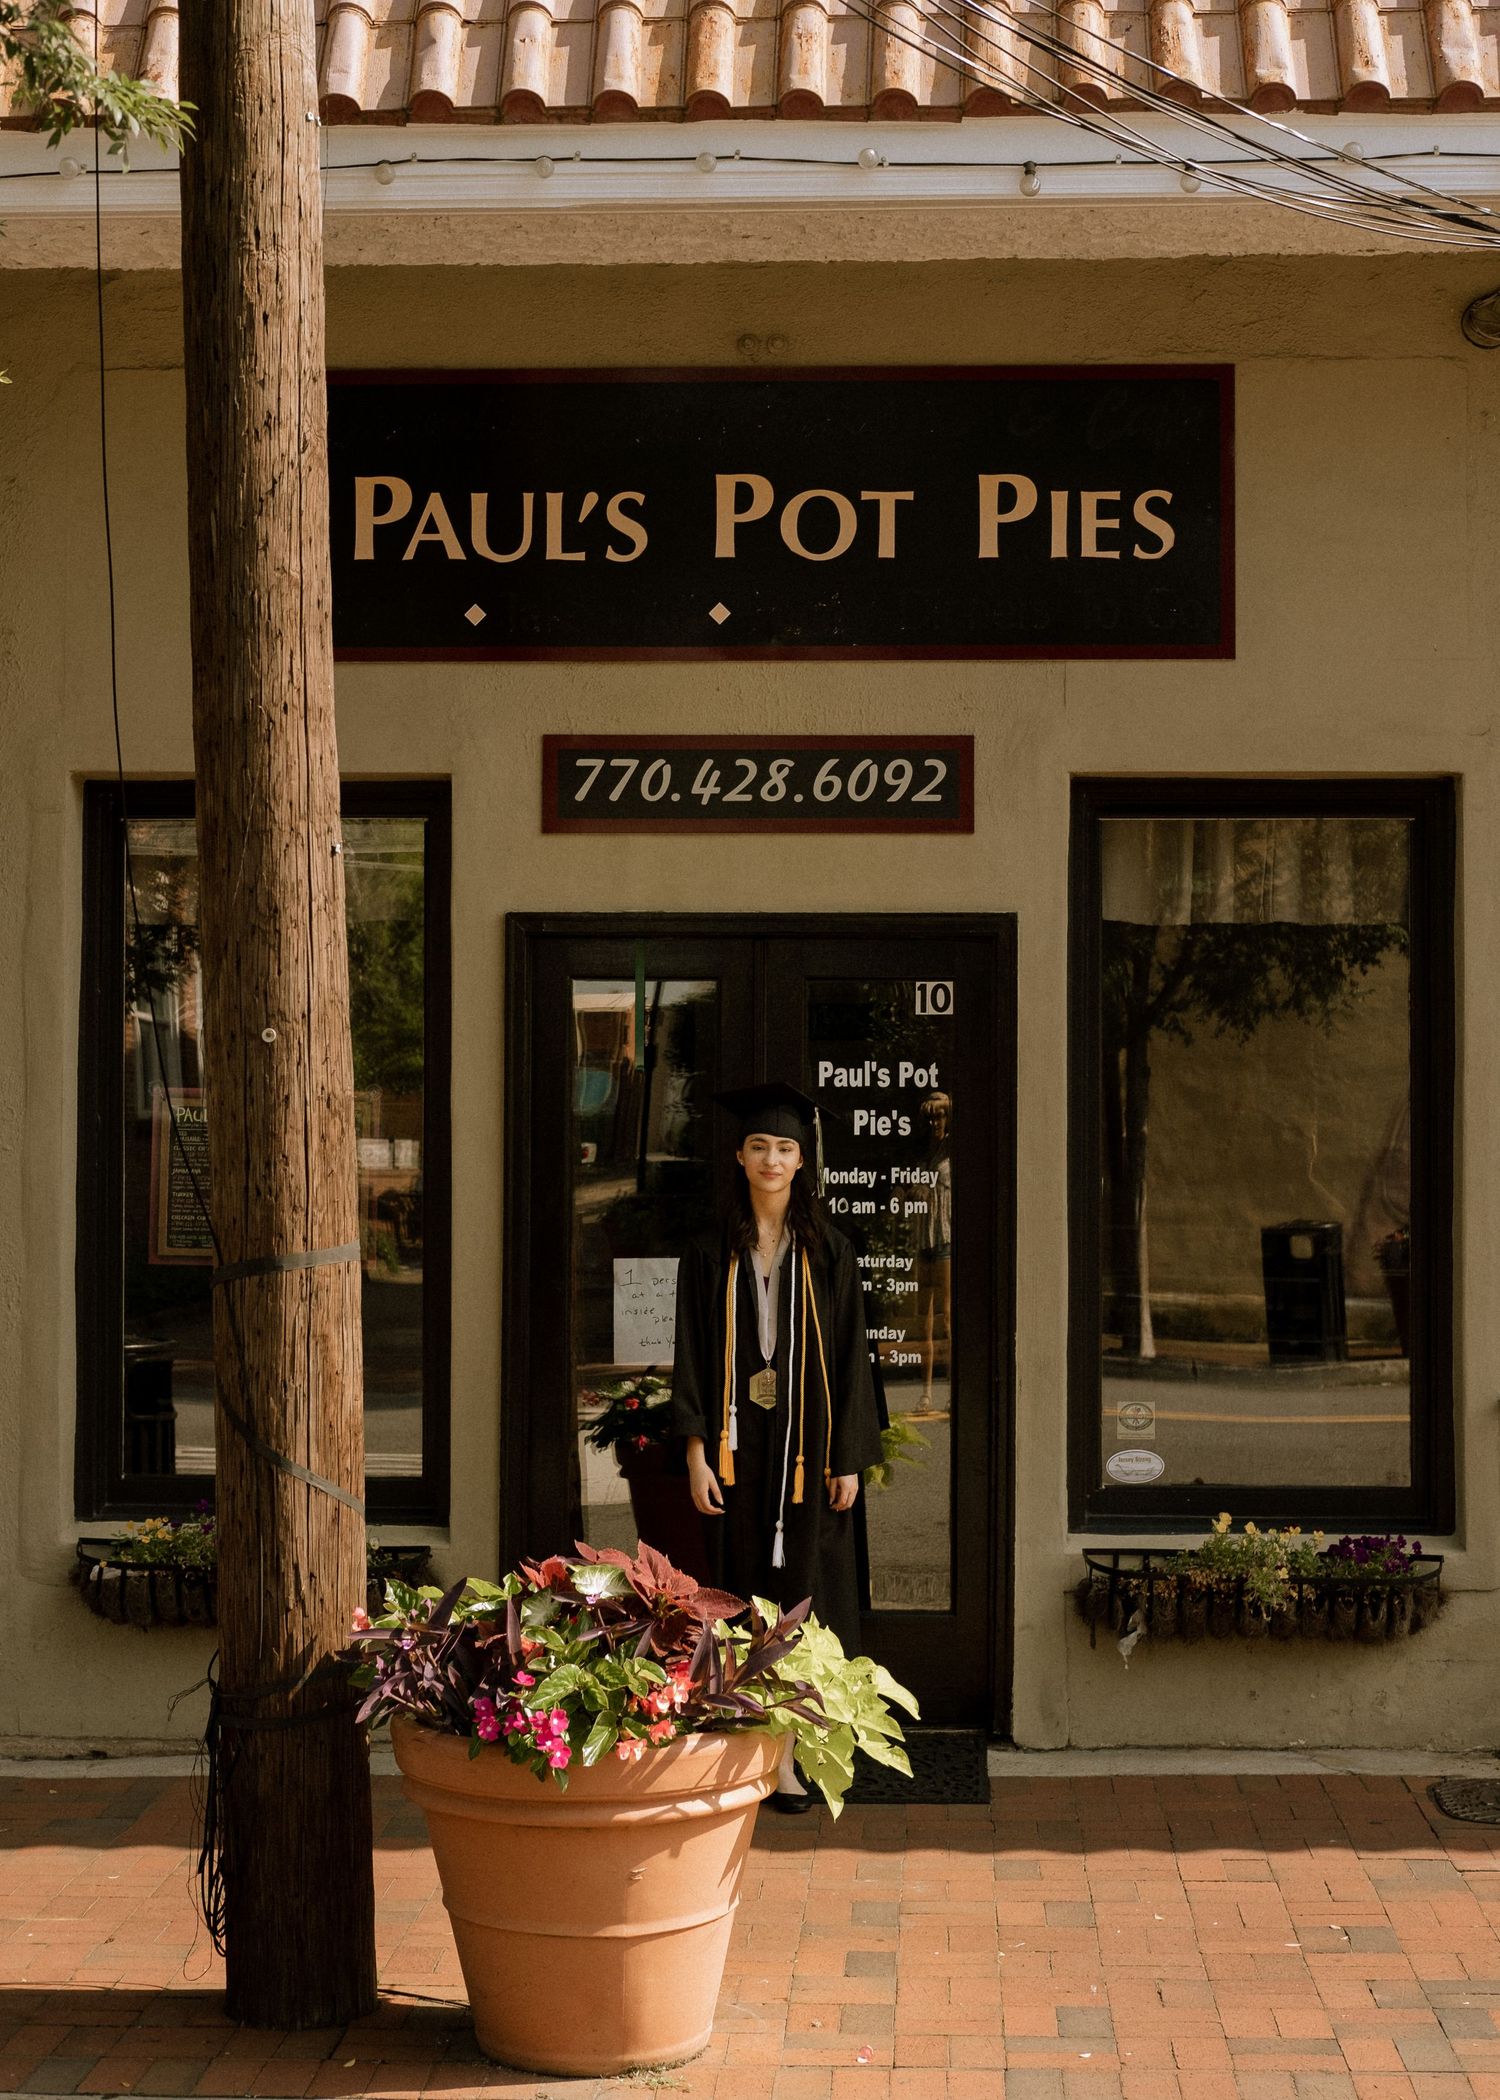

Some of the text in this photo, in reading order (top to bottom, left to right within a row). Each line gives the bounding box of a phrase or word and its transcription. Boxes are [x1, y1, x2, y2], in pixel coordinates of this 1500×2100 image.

[355, 474, 1175, 562] PAUL'S POT PIES
[575, 759, 946, 805] 770.428.6092
[917, 983, 950, 1013] 10
[818, 1061, 938, 1087] Paul's Pot
[176, 1107, 208, 1122] PAUL
[853, 1109, 911, 1136] Pie's
[891, 1167, 939, 1188] Friday
[829, 1197, 849, 1214] 10
[852, 1201, 876, 1214] am
[890, 1197, 899, 1214] 6
[905, 1201, 928, 1218] pm
[857, 1255, 913, 1271] aturday
[651, 1277, 676, 1286] pers
[886, 1278, 919, 1294] 3pm
[653, 1315, 673, 1325] plea
[866, 1326, 906, 1342] nday
[889, 1350, 921, 1366] 3pm
